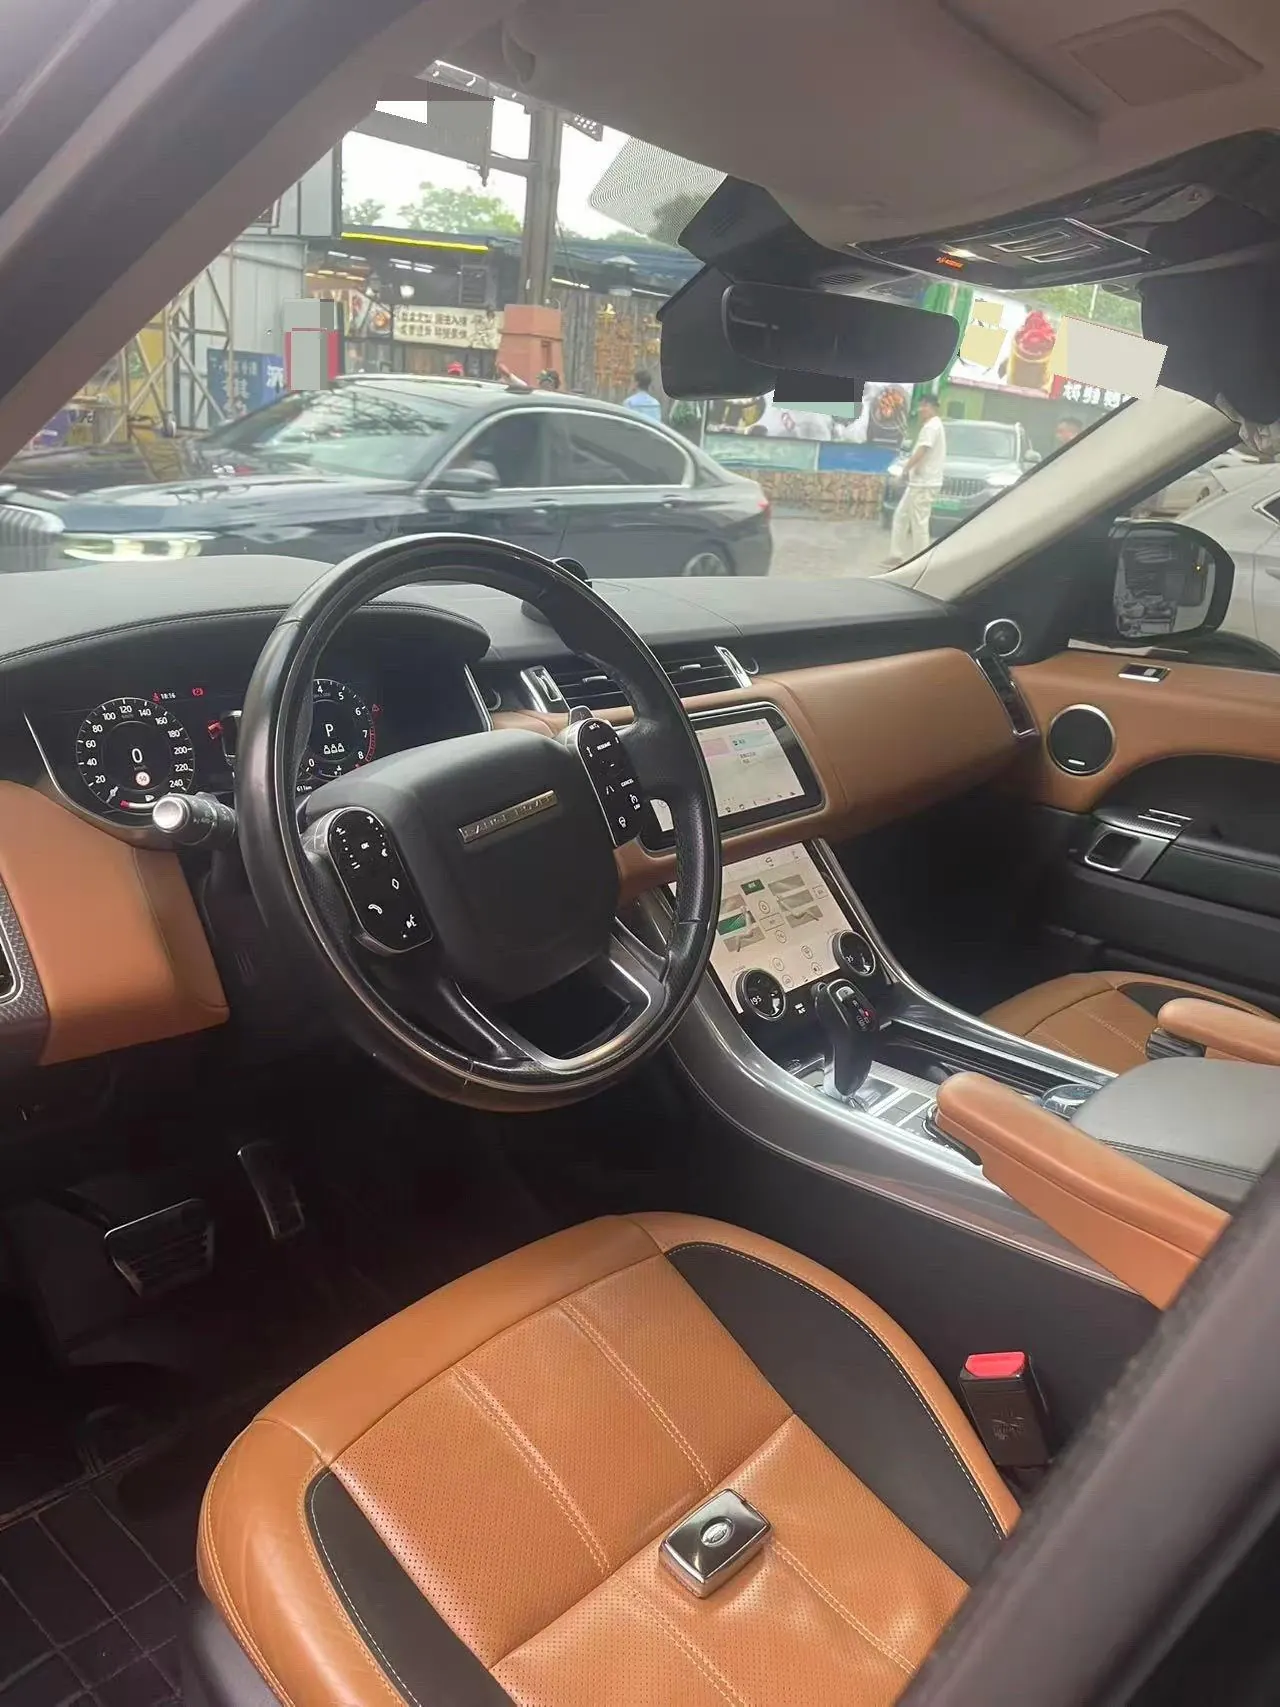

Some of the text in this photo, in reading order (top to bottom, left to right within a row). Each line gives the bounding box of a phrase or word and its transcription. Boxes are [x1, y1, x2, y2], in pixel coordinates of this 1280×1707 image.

[317, 685, 324, 694] 4
[338, 692, 344, 700] 5
[119, 705, 132, 714] 120
[138, 708, 152, 717] 140
[355, 707, 361, 716] 6
[102, 711, 116, 721] 100
[155, 717, 168, 726] 160
[92, 724, 103, 733] 80
[325, 723, 334, 738] P
[167, 730, 180, 739] 180
[362, 729, 368, 738] 7
[85, 740, 97, 749] 60
[173, 746, 188, 755] 200
[131, 748, 142, 763] 0
[357, 751, 364, 760] 8
[86, 757, 98, 766] 40
[308, 758, 315, 767] 0
[174, 763, 189, 772] 220
[95, 775, 106, 784] 20
[169, 779, 183, 788] 240
